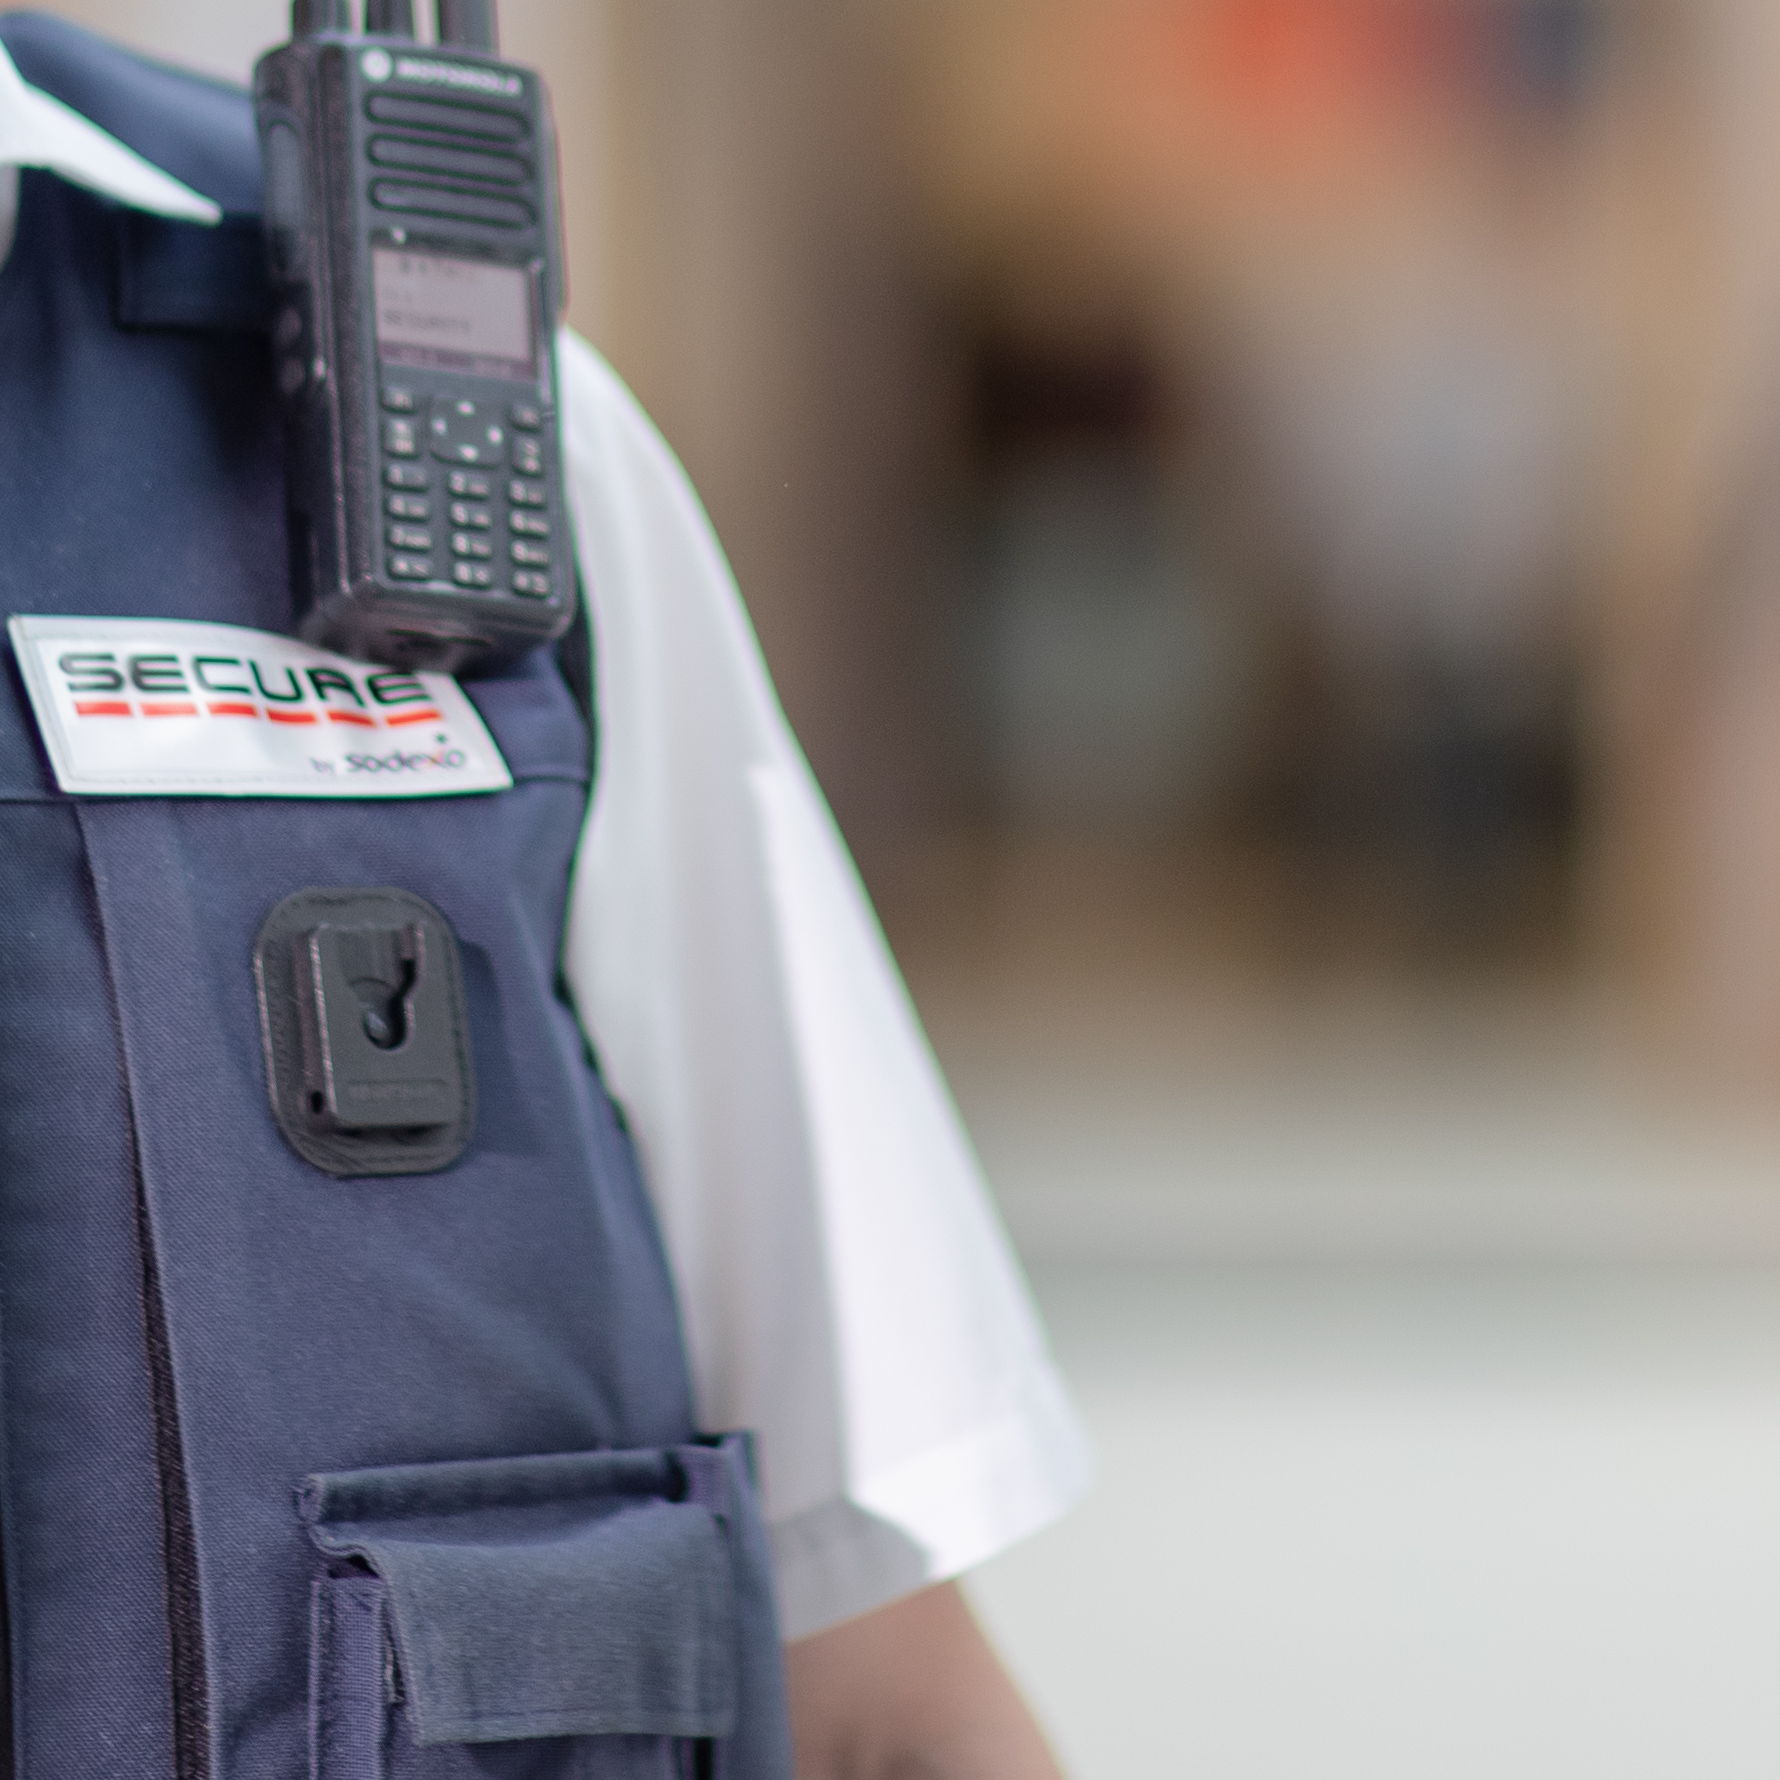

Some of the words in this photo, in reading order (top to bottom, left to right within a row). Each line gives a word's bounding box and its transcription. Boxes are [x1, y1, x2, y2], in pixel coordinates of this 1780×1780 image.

[396, 58, 522, 97] MOTOROLA
[59, 653, 433, 708] SECURE
[345, 747, 466, 774] sodexo
